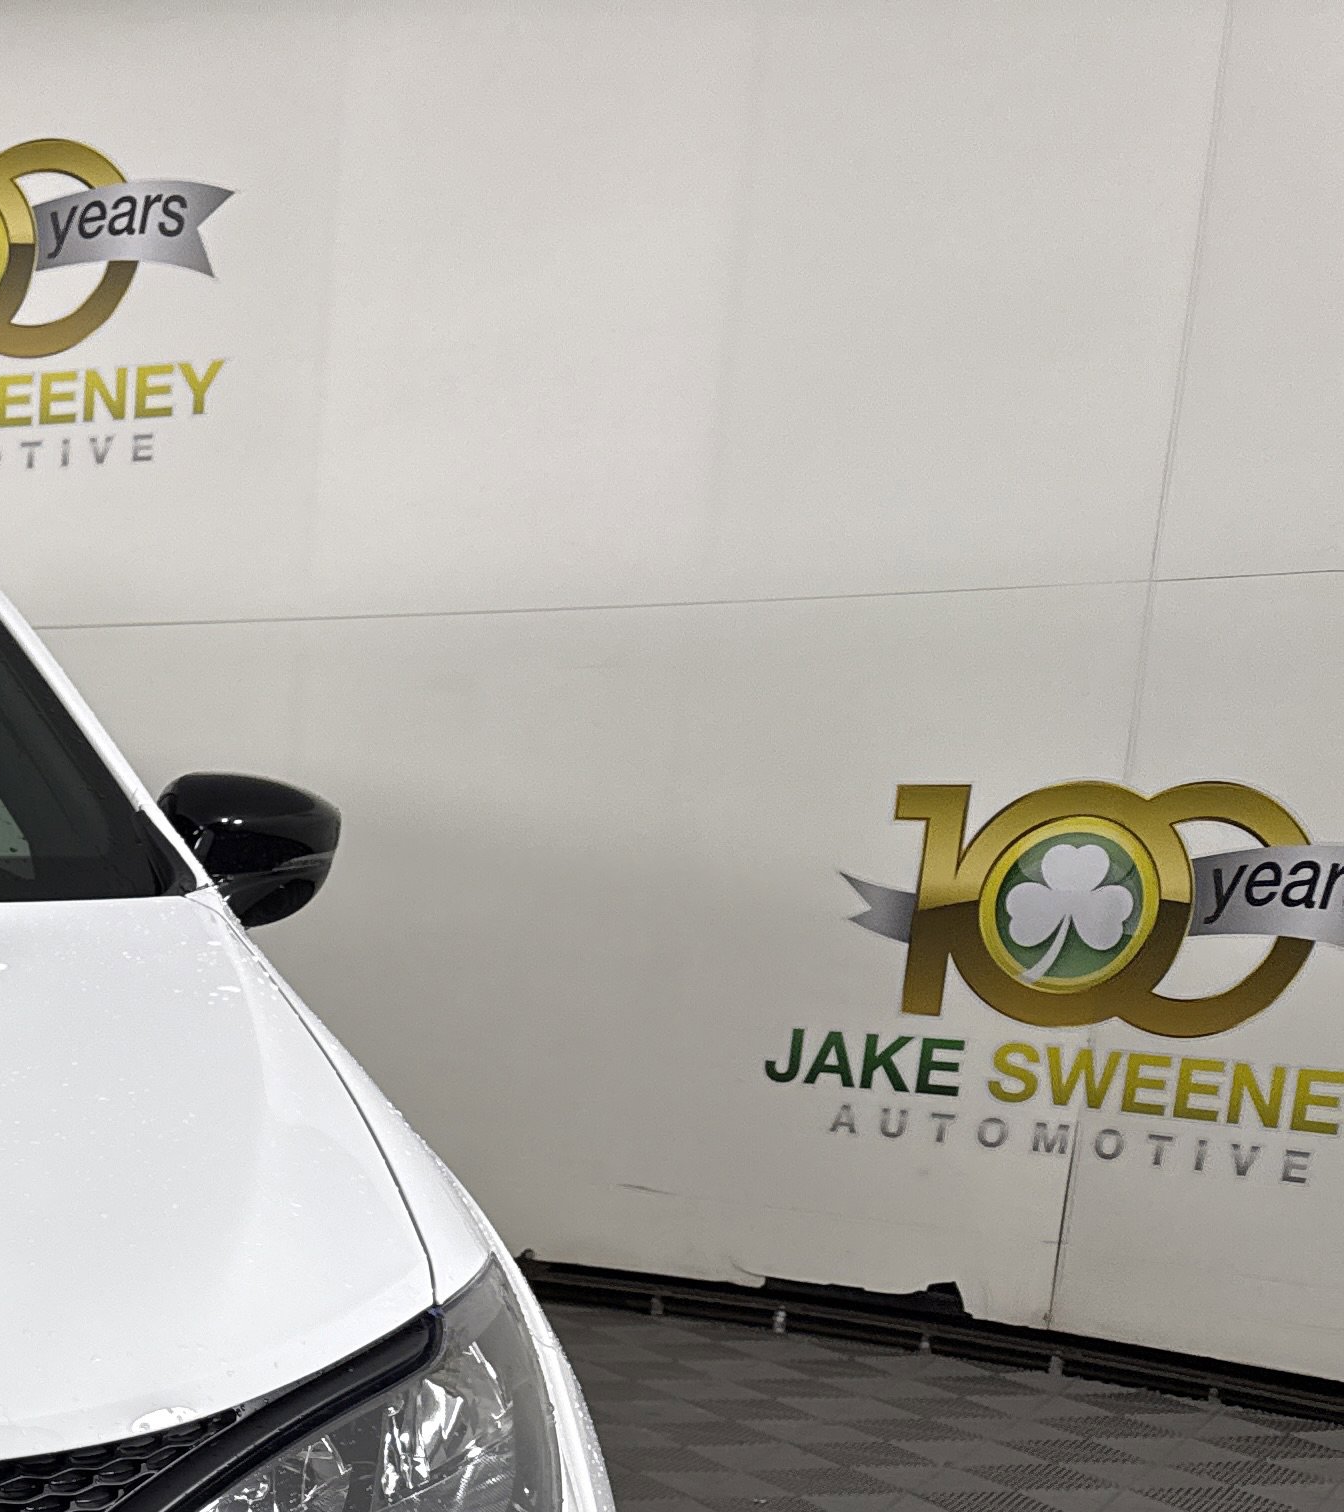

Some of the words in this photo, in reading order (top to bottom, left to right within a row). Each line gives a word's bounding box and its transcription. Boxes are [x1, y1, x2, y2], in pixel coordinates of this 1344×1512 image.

[47, 193, 188, 258] years
[893, 780, 1315, 1039] 100
[764, 1029, 966, 1097] JAKE
[987, 1042, 1344, 1135] SWEENE
[829, 1104, 1313, 1184] AUTOMOTIVE
